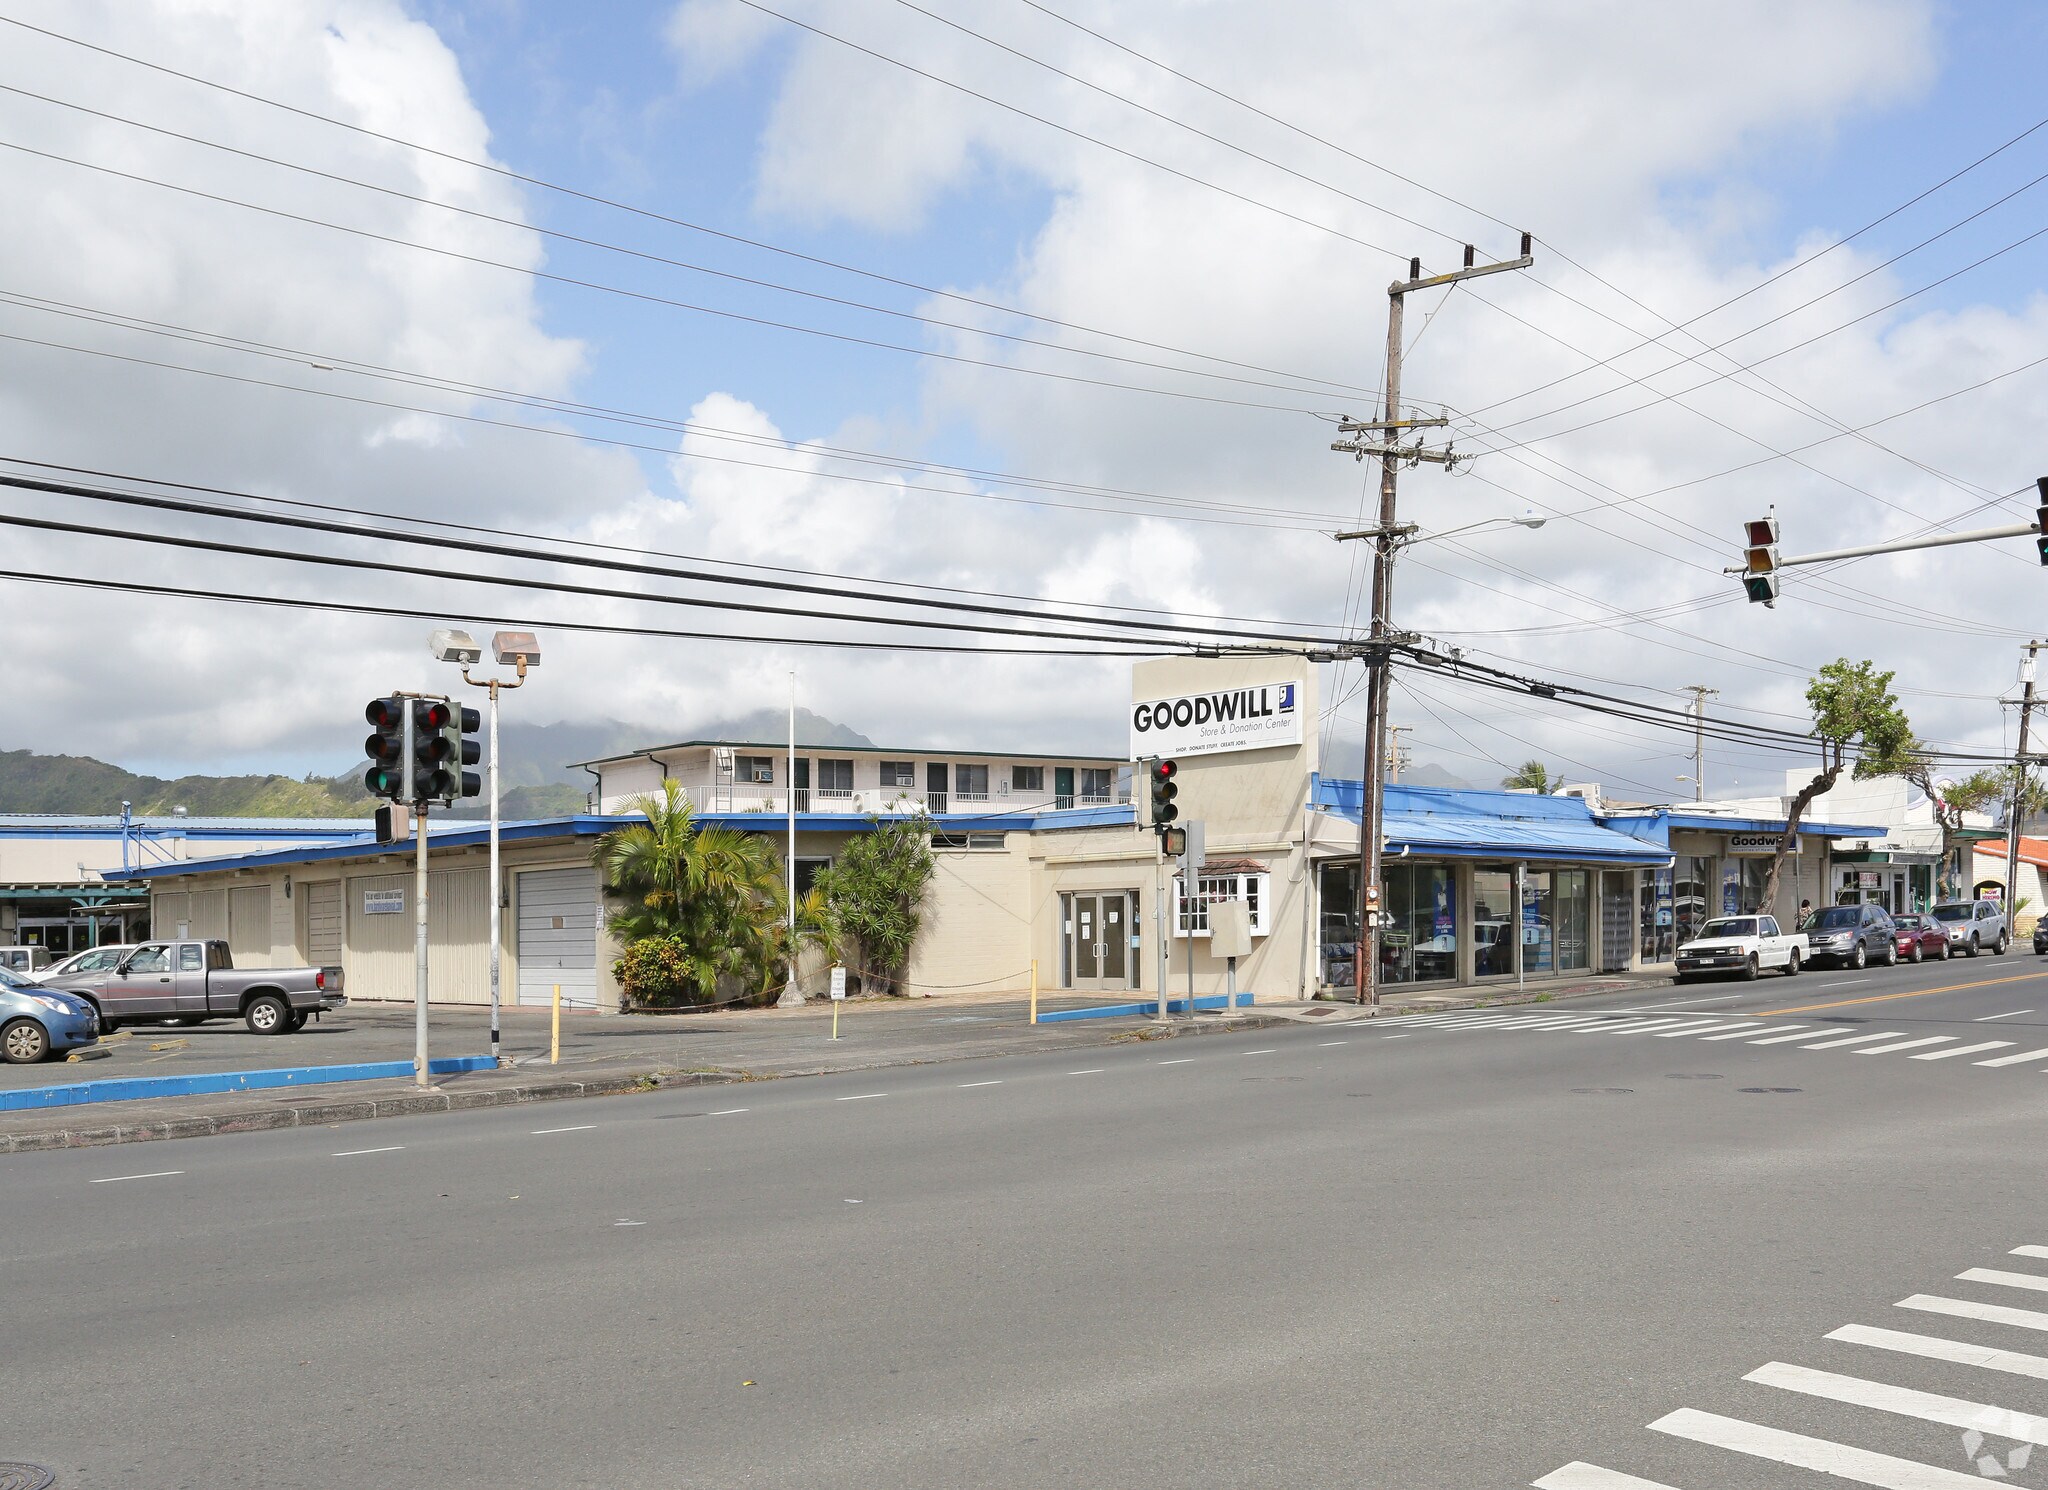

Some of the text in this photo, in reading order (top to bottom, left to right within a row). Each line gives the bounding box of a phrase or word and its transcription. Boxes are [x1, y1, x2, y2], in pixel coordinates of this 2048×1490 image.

[1134, 688, 1273, 732] GOODWILL
[1200, 718, 1291, 737] Store & Donation Center
[1731, 836, 1783, 846] Goodwi
